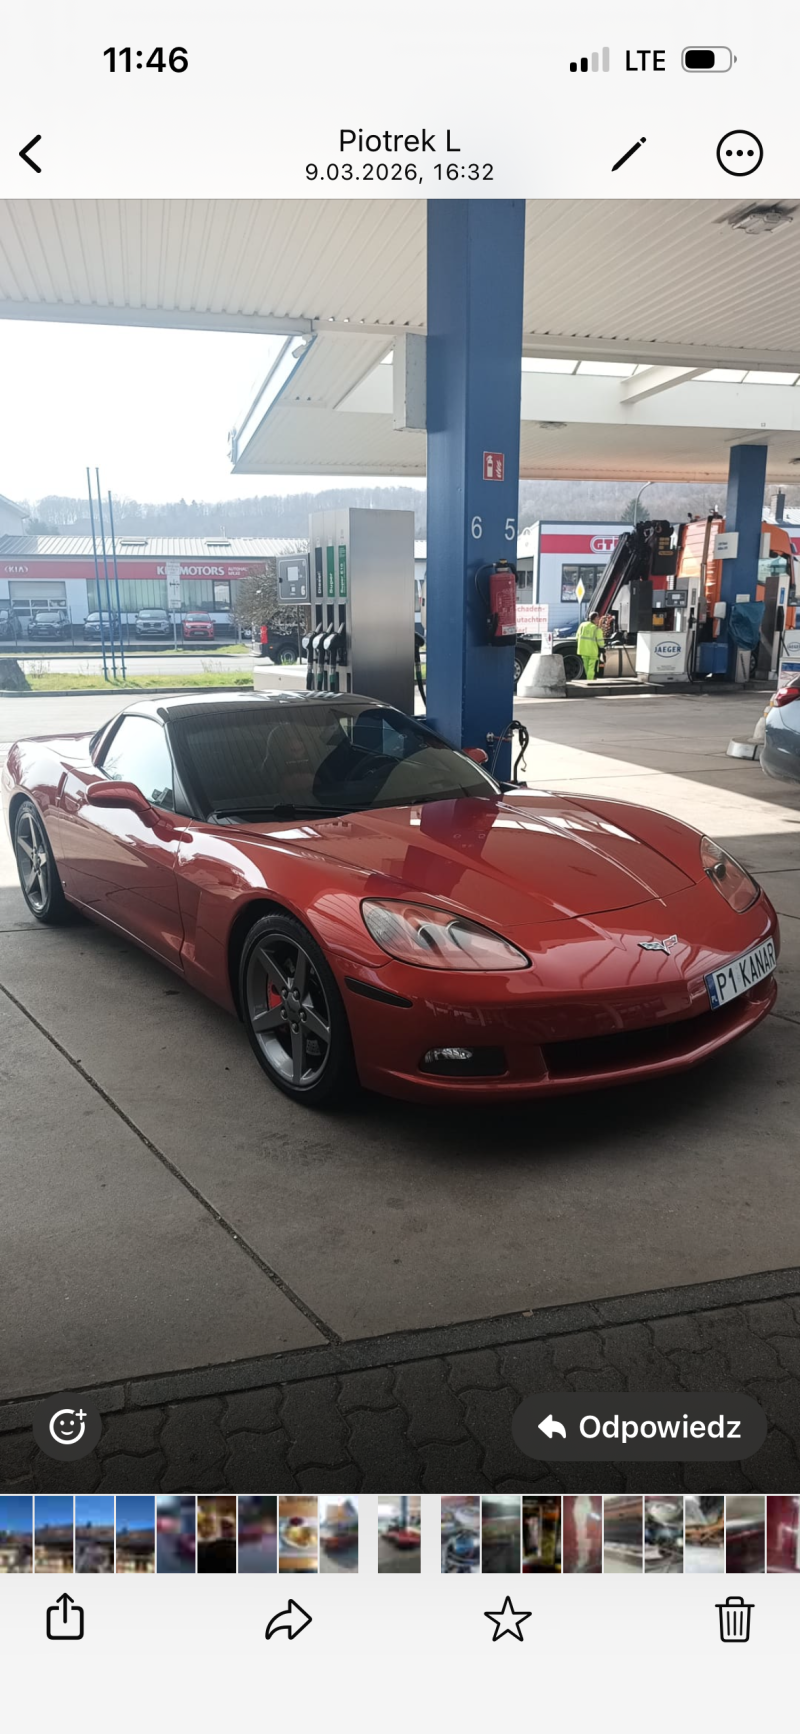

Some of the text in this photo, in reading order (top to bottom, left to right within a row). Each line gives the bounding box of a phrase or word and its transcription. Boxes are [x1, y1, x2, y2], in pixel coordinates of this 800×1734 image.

[471, 515, 516, 541] 6 5
[180, 565, 225, 576] MOTORS
[716, 941, 777, 1001] P1 KANAR
